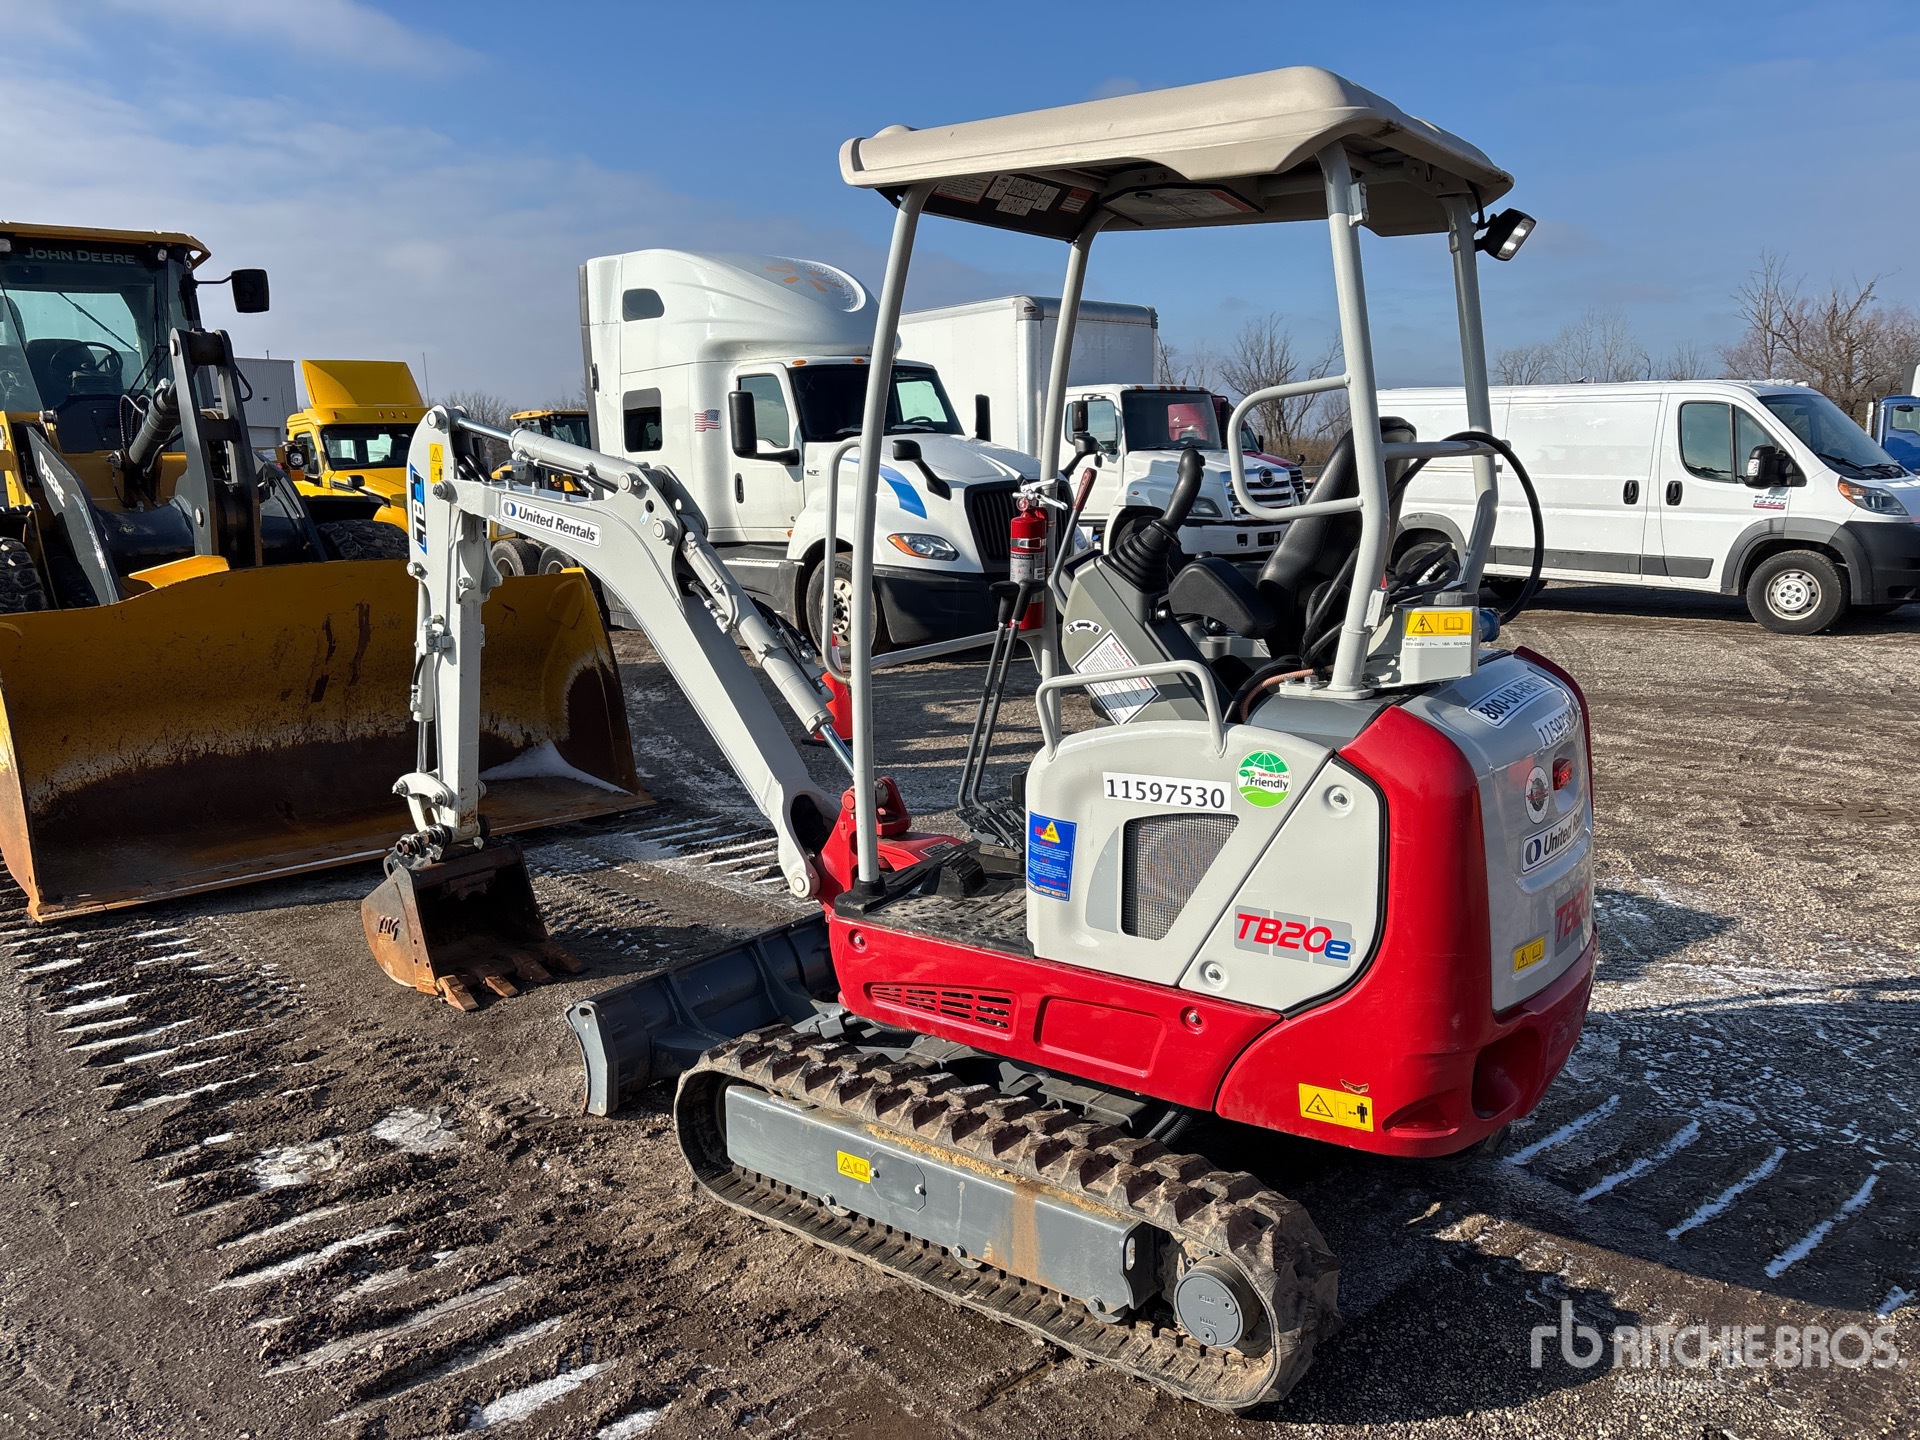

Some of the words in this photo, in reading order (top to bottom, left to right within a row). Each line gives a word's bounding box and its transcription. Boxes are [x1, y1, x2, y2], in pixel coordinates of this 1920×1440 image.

[77, 249, 136, 264] DEERE
[38, 450, 66, 508] DEERE
[518, 506, 554, 529] United
[555, 517, 596, 541] Rentals
[1106, 778, 1225, 809] 11597530
[1249, 776, 1290, 791] Friendly
[1543, 818, 1574, 856] United
[1237, 912, 1351, 961] TB20e
